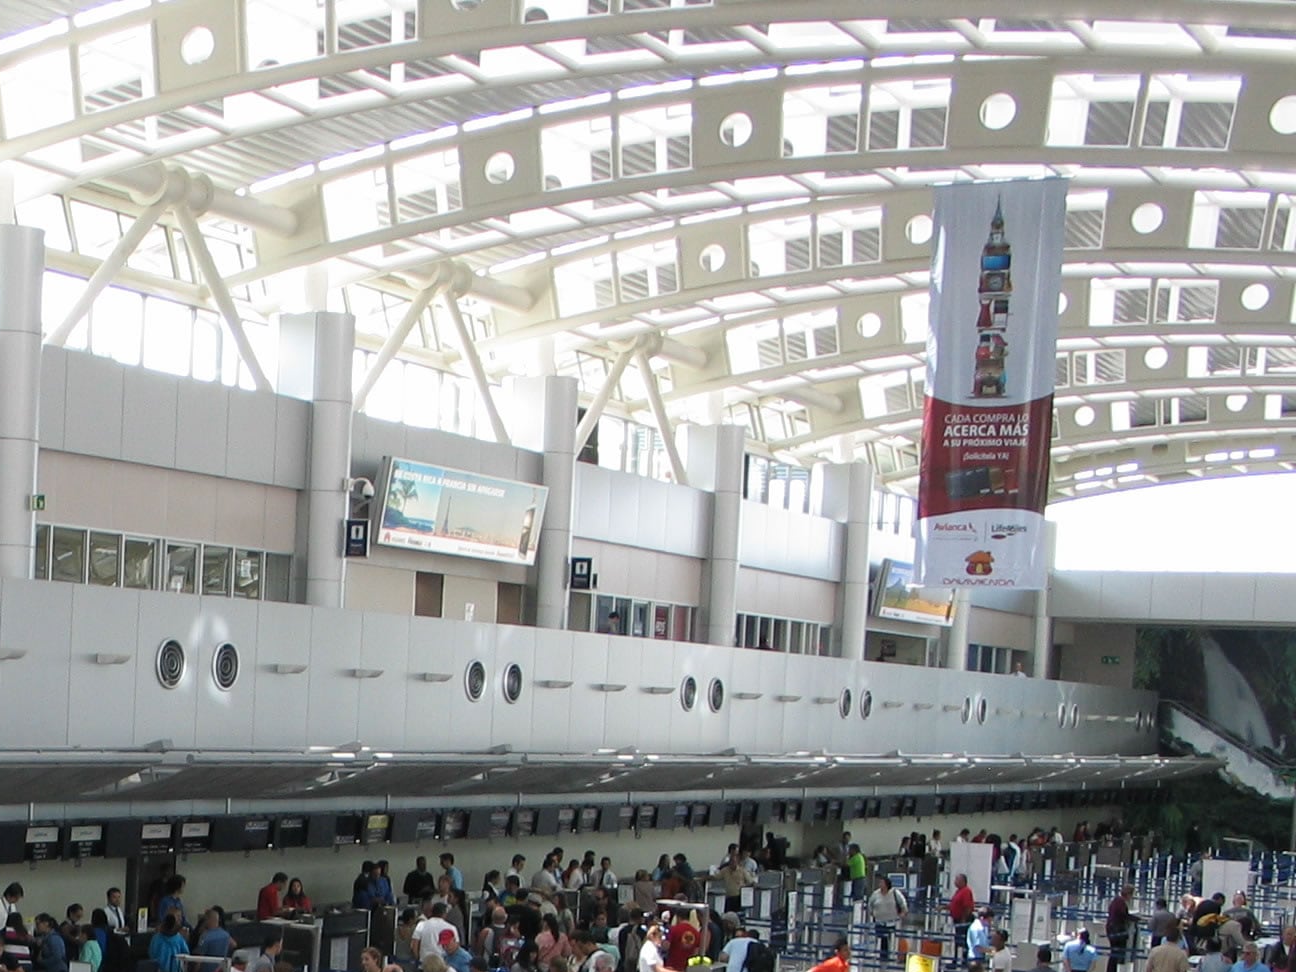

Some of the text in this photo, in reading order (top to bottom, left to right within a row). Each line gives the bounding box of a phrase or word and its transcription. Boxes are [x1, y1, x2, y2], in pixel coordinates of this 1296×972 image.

[944, 413, 1029, 424] CADA COMPRA LO
[944, 422, 1030, 437] ACERCA MÁS
[943, 439, 950, 448] A
[951, 439, 961, 448] SU
[962, 437, 1003, 447] PRÓXIMO
[934, 523, 968, 532] Avianca
